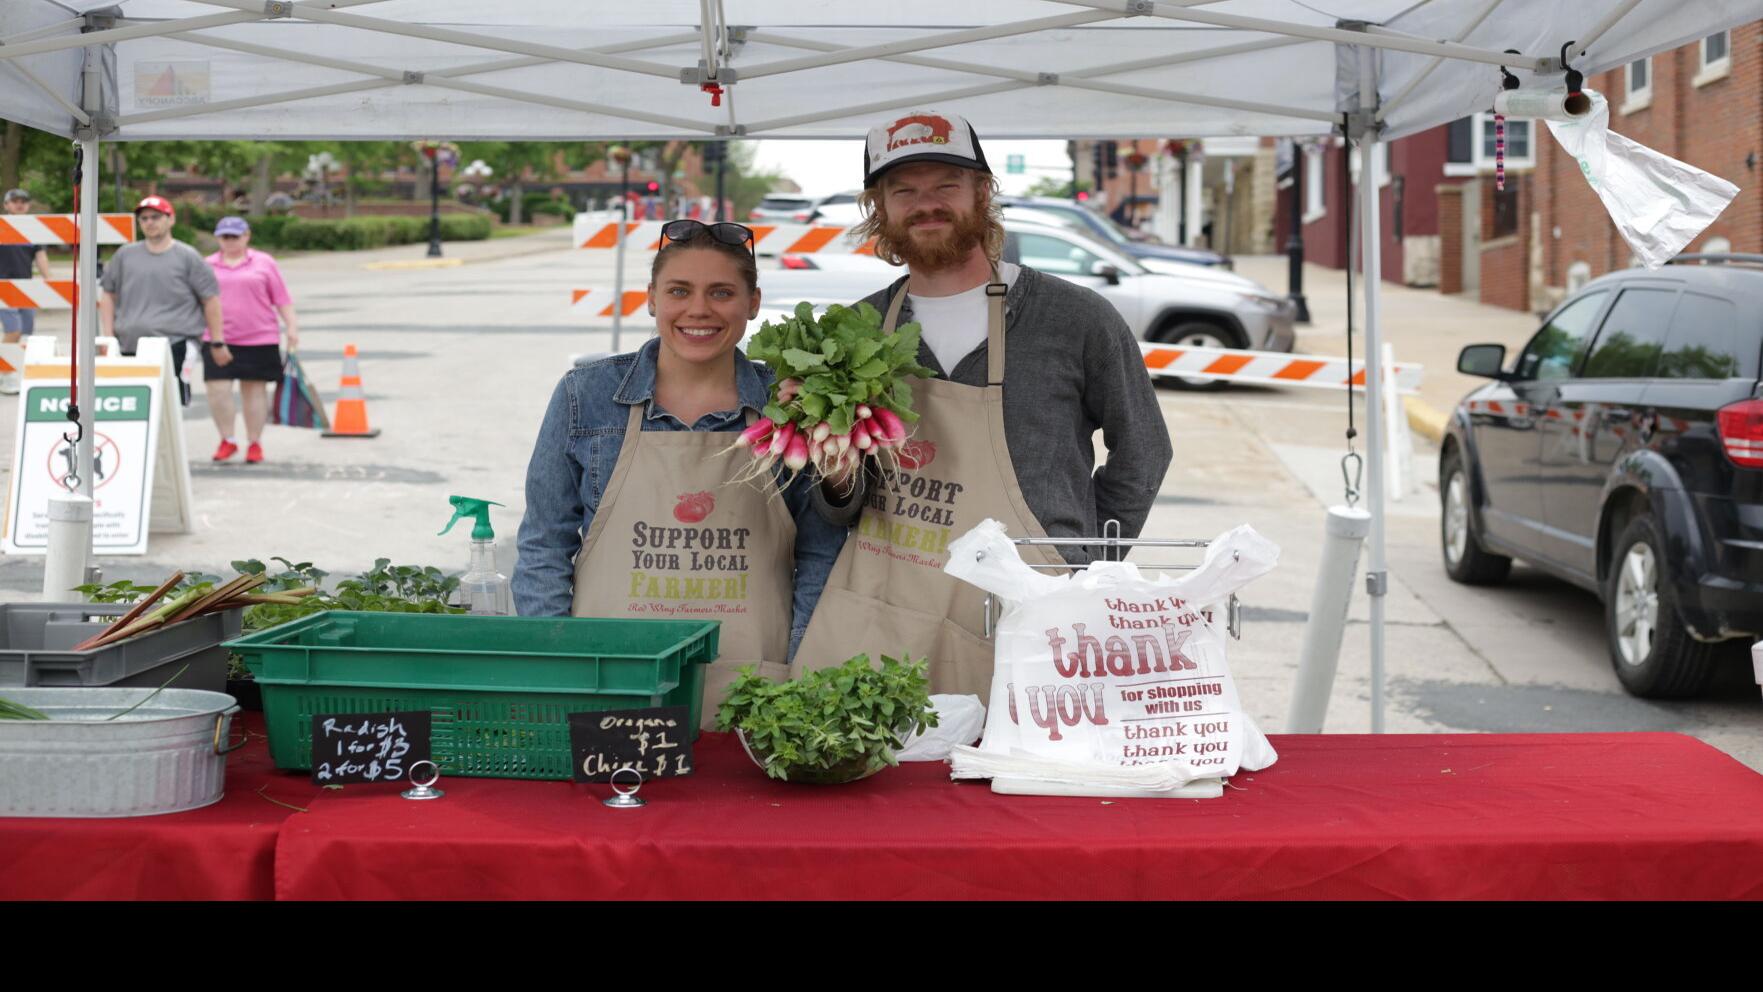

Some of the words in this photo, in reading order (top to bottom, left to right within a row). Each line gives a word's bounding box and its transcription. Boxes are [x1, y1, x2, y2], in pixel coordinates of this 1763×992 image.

[40, 397, 137, 412] NOICE
[893, 496, 954, 526] LOCAL
[632, 521, 750, 550] SUPPORT
[631, 550, 680, 570] YOUR
[690, 551, 749, 571] LOCAL
[628, 571, 750, 600] FARMER!
[627, 603, 647, 612] Red
[649, 603, 675, 615] Wing
[676, 603, 712, 614] Farmers
[713, 603, 747, 614] Market
[1104, 598, 1169, 613] thank
[1108, 615, 1171, 630] thank
[1045, 623, 1197, 678] thank
[1120, 690, 1143, 702] for
[1147, 682, 1222, 700] shopping
[1025, 682, 1109, 741] you
[1145, 700, 1180, 715] with
[1183, 700, 1203, 712] us
[322, 717, 407, 739] Radish
[1124, 722, 1188, 740] thank
[1193, 721, 1229, 737] you
[337, 740, 342, 756] 1
[348, 740, 374, 754] for
[375, 735, 410, 759] $3
[629, 731, 678, 756] $1
[1123, 742, 1188, 758] thank
[1193, 741, 1229, 756] you
[318, 762, 332, 779] 2
[335, 760, 364, 776] for
[364, 758, 403, 781] $5
[1190, 757, 1226, 767] you
